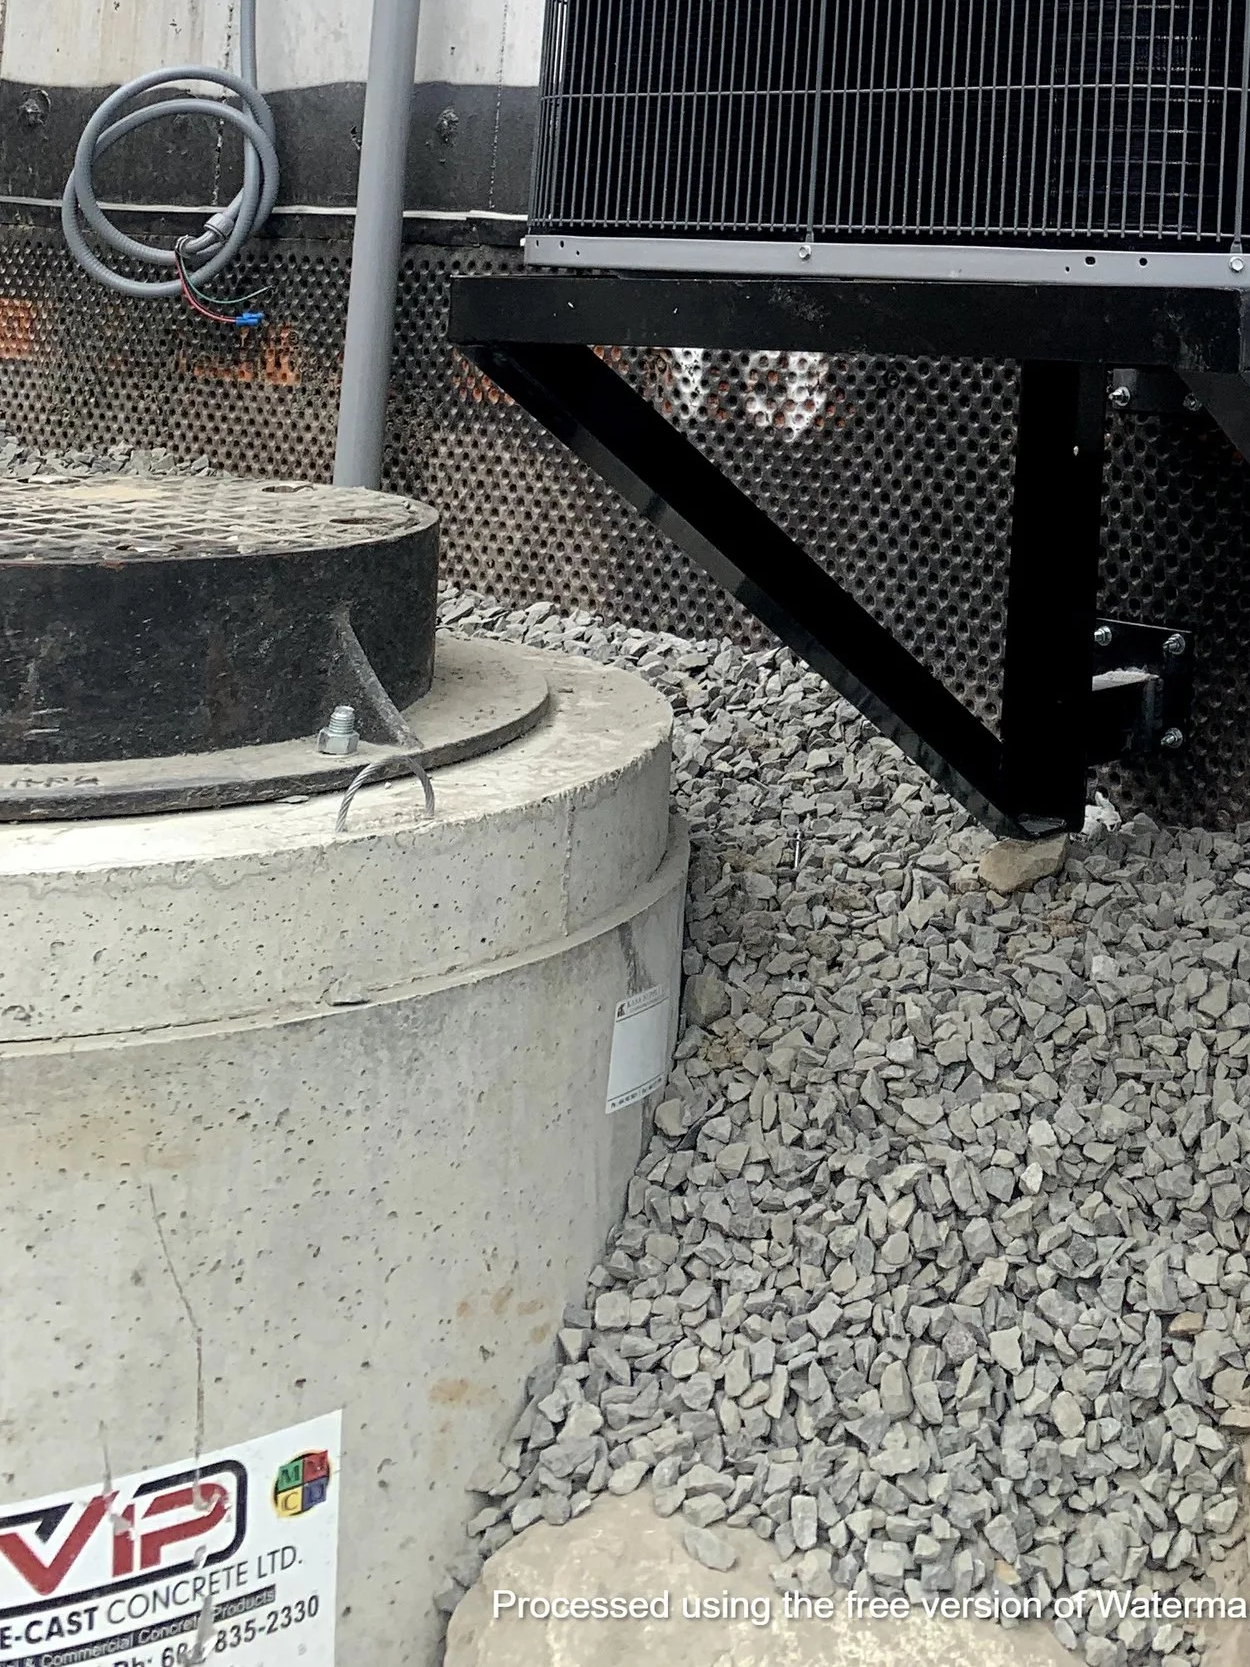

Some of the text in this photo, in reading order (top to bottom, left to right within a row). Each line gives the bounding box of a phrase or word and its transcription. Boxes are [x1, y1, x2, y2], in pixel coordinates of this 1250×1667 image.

[107, 1561, 249, 1624] CONCRETE
[257, 1546, 304, 1579] LTD.
[215, 1594, 320, 1653] 835-2330
[42, 1634, 133, 1667] Commercial
[138, 1613, 204, 1644] Concret
[213, 1589, 276, 1620] Products
